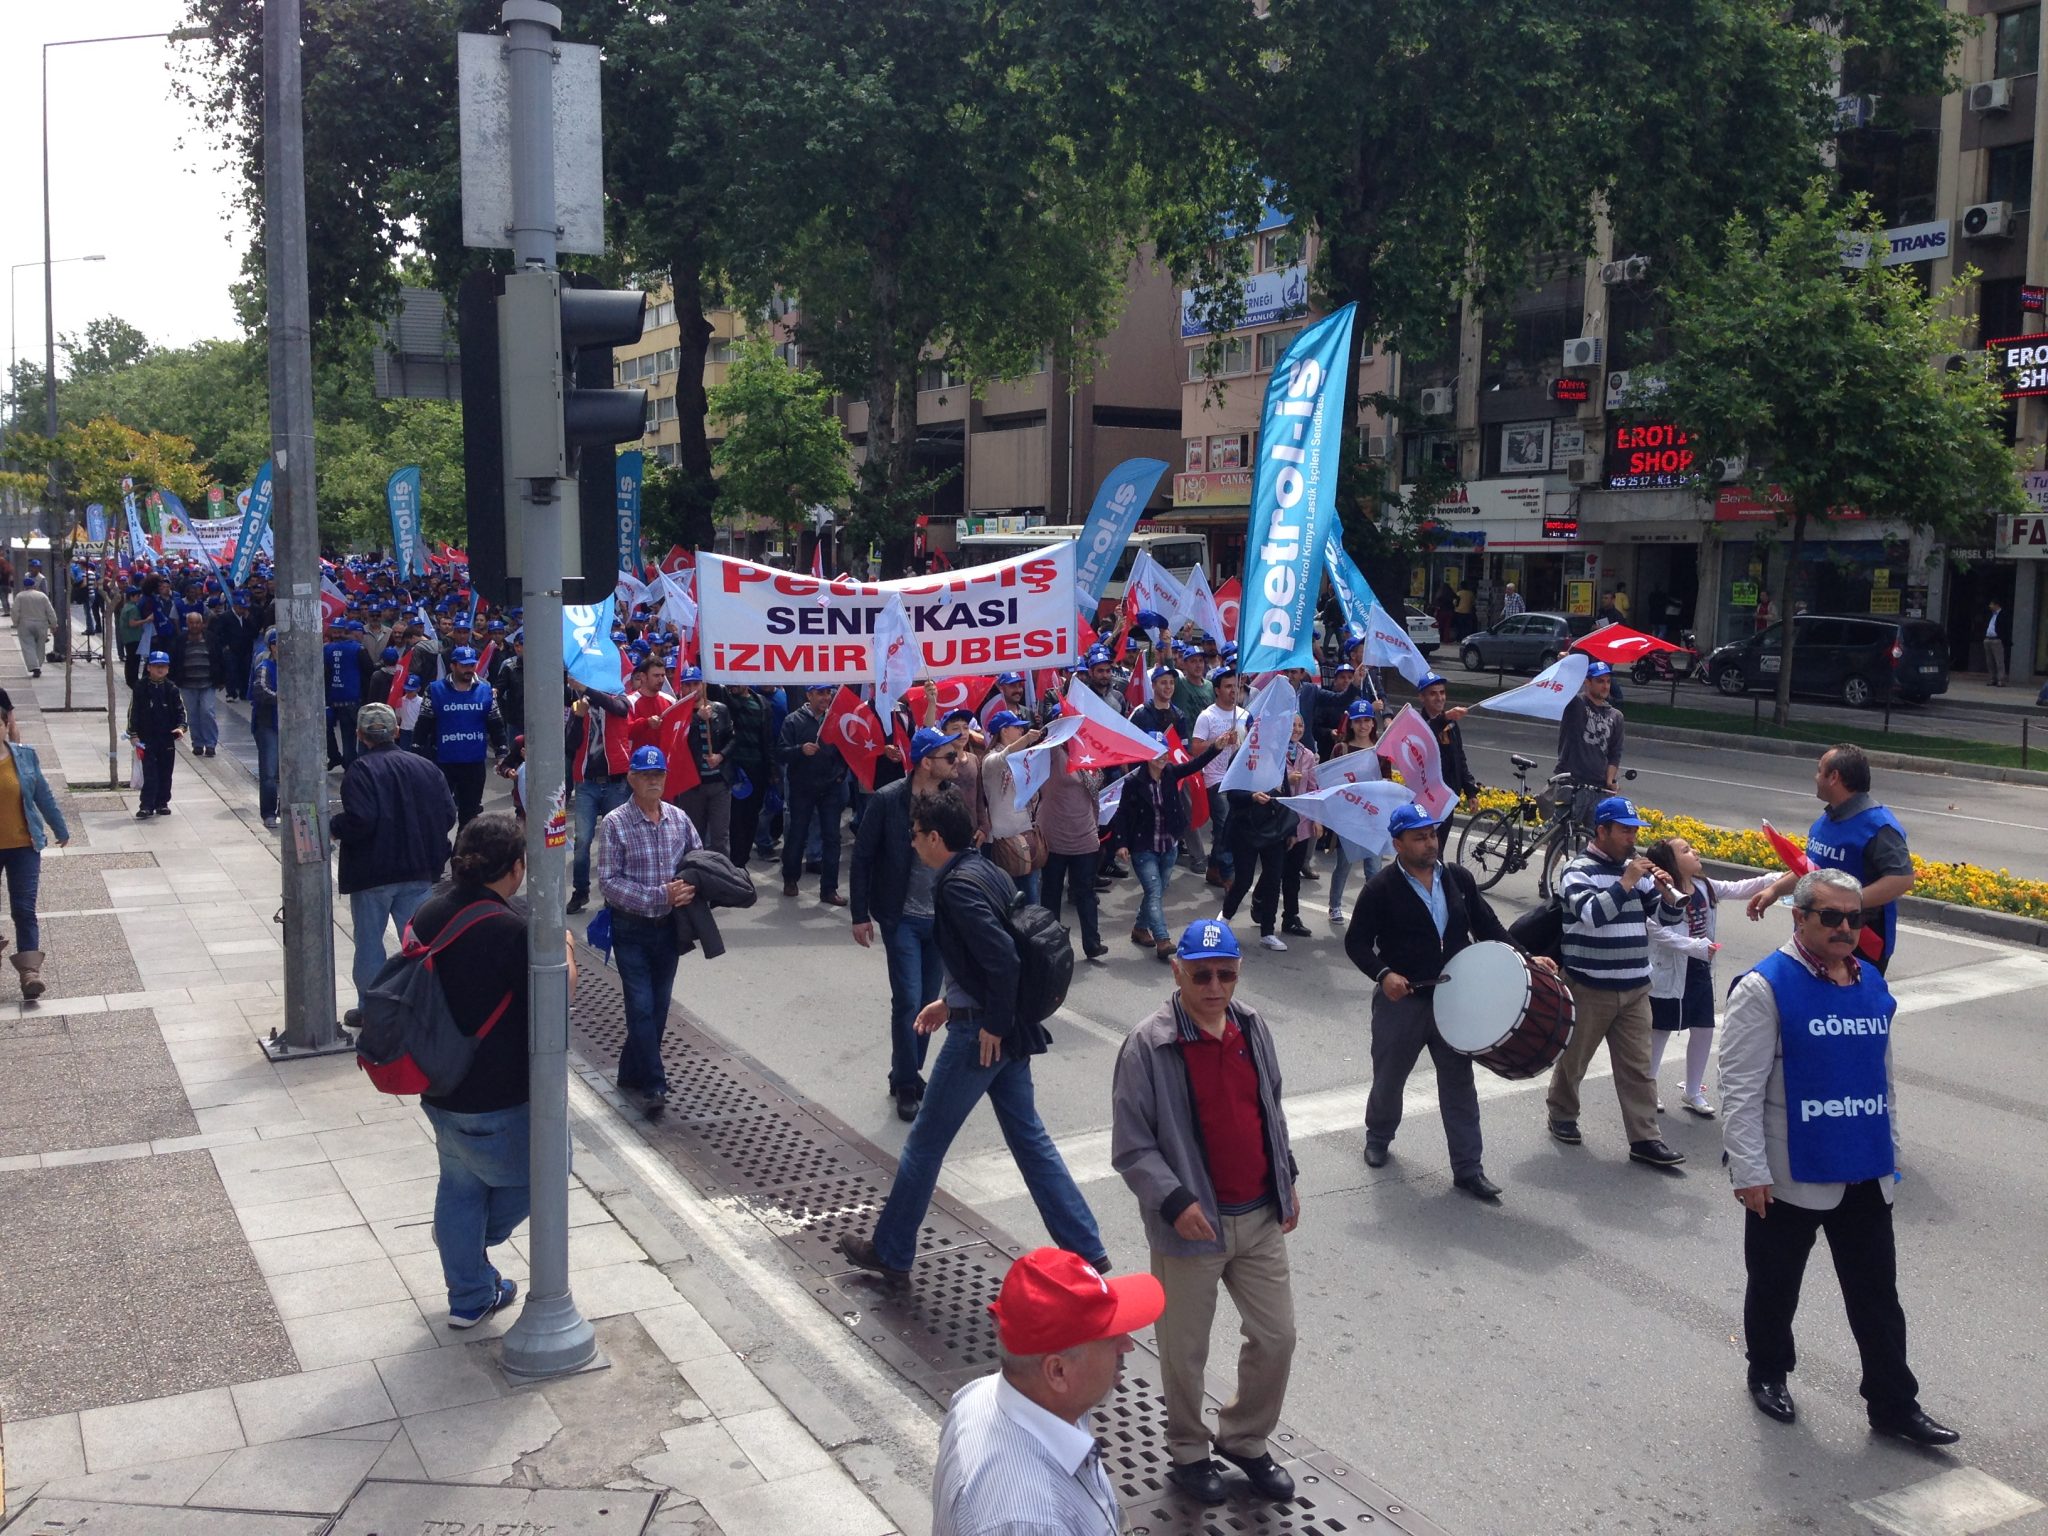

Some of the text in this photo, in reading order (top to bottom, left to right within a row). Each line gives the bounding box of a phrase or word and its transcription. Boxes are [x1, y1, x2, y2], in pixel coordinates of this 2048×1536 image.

[2017, 368, 2048, 389] SH
[1630, 450, 1695, 474] SHOP
[1260, 358, 1327, 652] petrol-iş
[714, 642, 868, 672] İZMİR
[443, 702, 484, 711] GÖREVLİ
[1808, 1014, 1889, 1036] GÖREVLİ
[1801, 1094, 1889, 1122] petrol-
